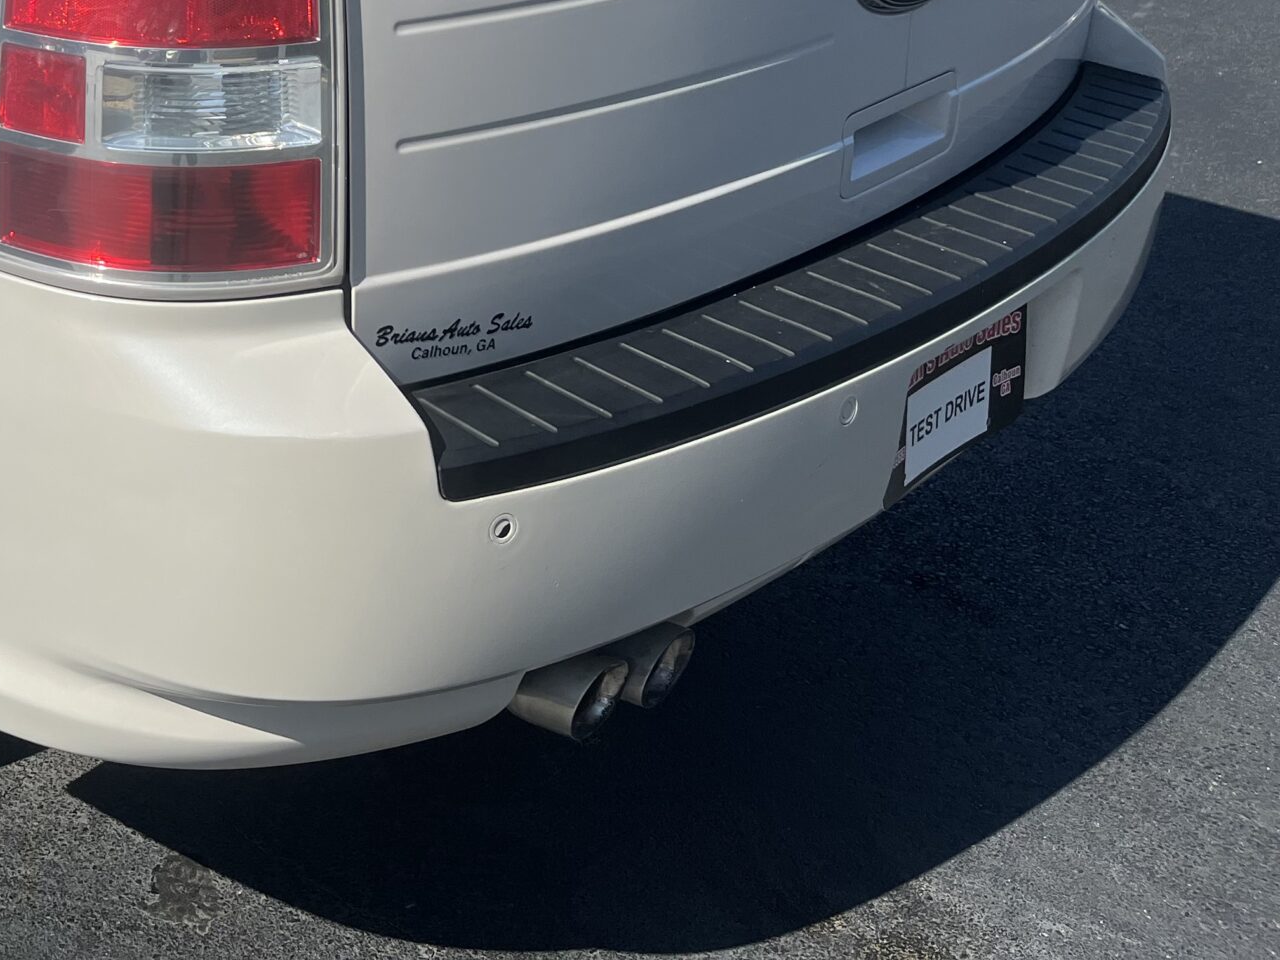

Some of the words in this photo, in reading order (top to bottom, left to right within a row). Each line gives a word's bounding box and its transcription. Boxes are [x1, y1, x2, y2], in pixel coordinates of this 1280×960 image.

[438, 318, 481, 341] Auto
[487, 312, 533, 334] Sales
[411, 345, 472, 360] Calhoun,
[477, 338, 496, 352] GA
[910, 407, 941, 446] TEST
[944, 381, 986, 423] DRIVE
